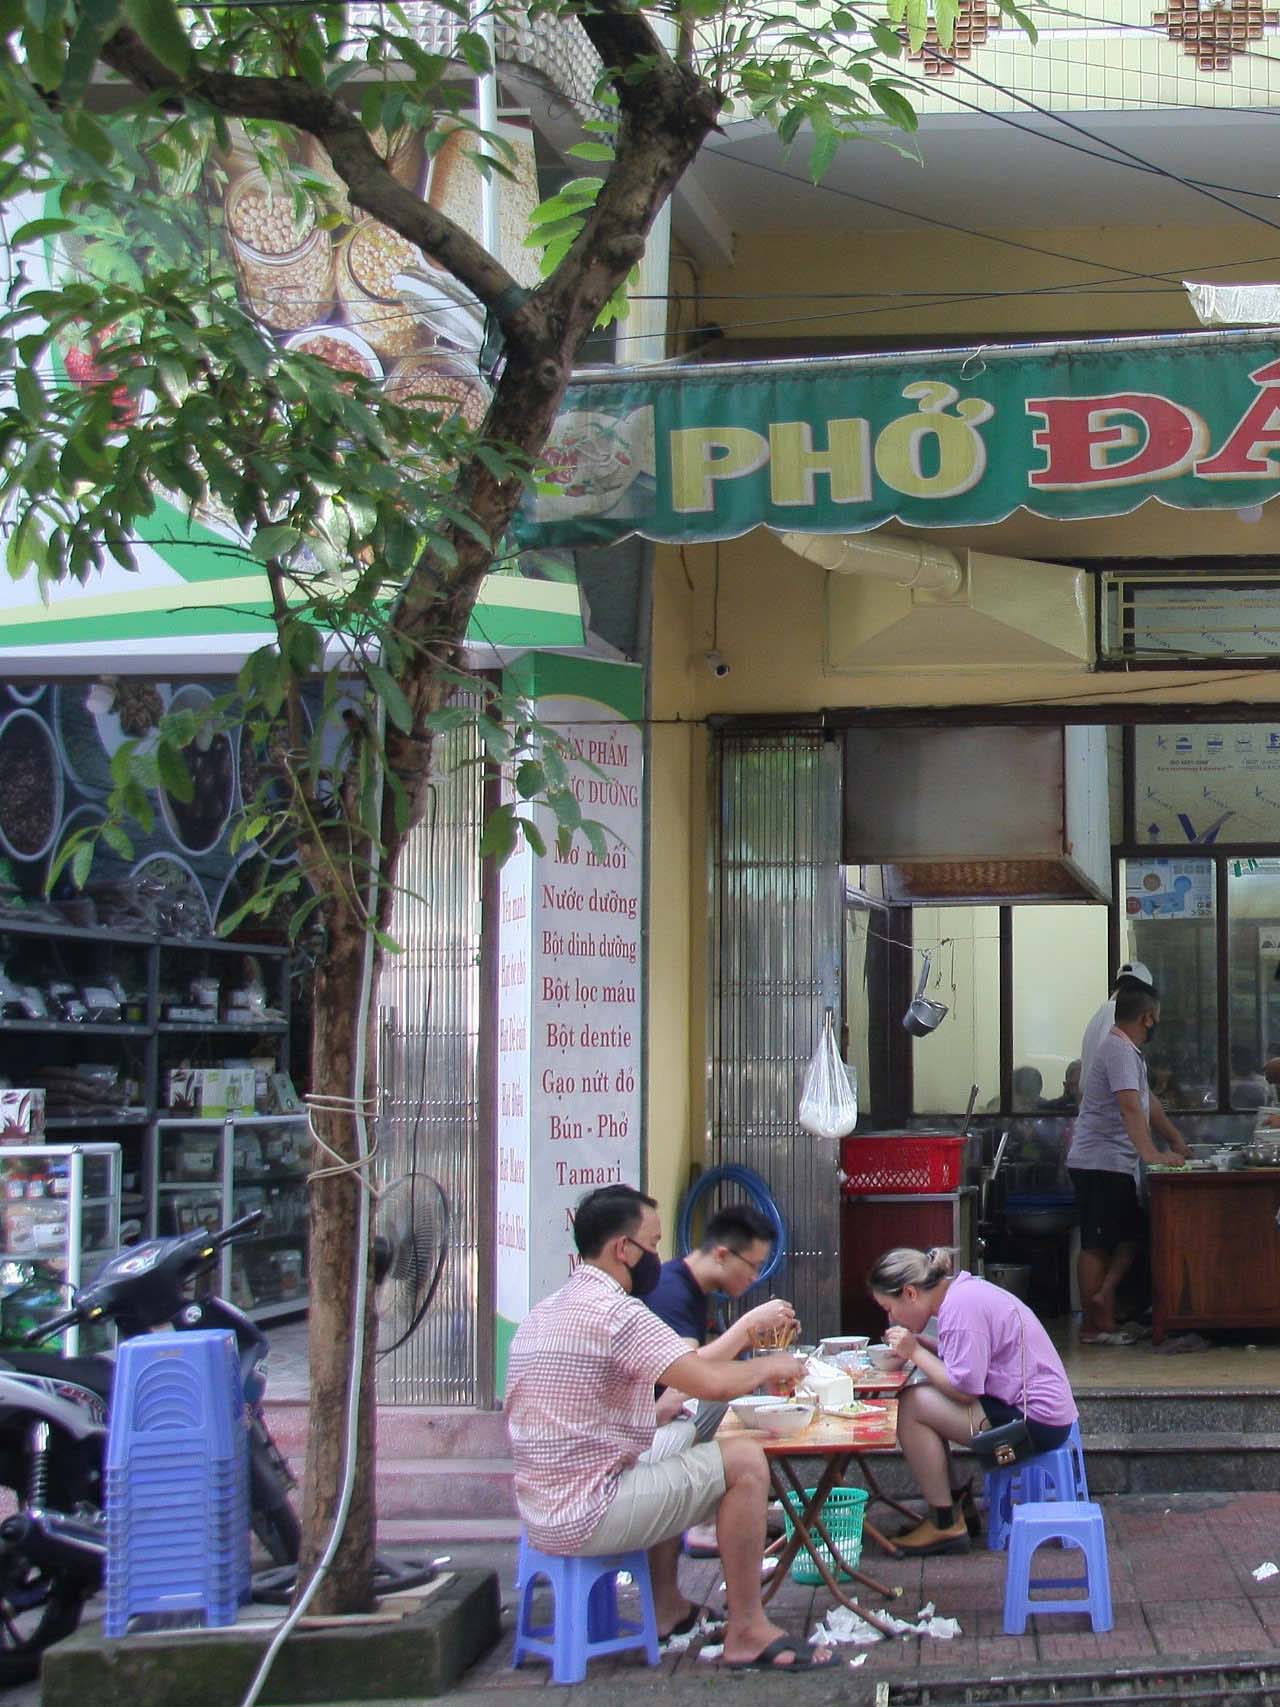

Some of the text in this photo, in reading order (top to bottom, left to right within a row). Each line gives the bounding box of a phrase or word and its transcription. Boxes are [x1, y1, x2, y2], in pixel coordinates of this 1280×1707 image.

[670, 381, 994, 513] PHỞ
[542, 884, 637, 920] Nước dưỡng
[542, 931, 564, 962] Bột
[568, 932, 595, 956] dinh
[542, 976, 635, 1008] Bột lọc máu
[547, 1023, 631, 1055] Bột dentie
[542, 1069, 575, 1101] Gạo
[582, 1069, 608, 1093] nứt
[550, 1115, 582, 1140] Bún
[597, 1112, 629, 1138] Phở
[556, 1160, 621, 1186] Tamari
